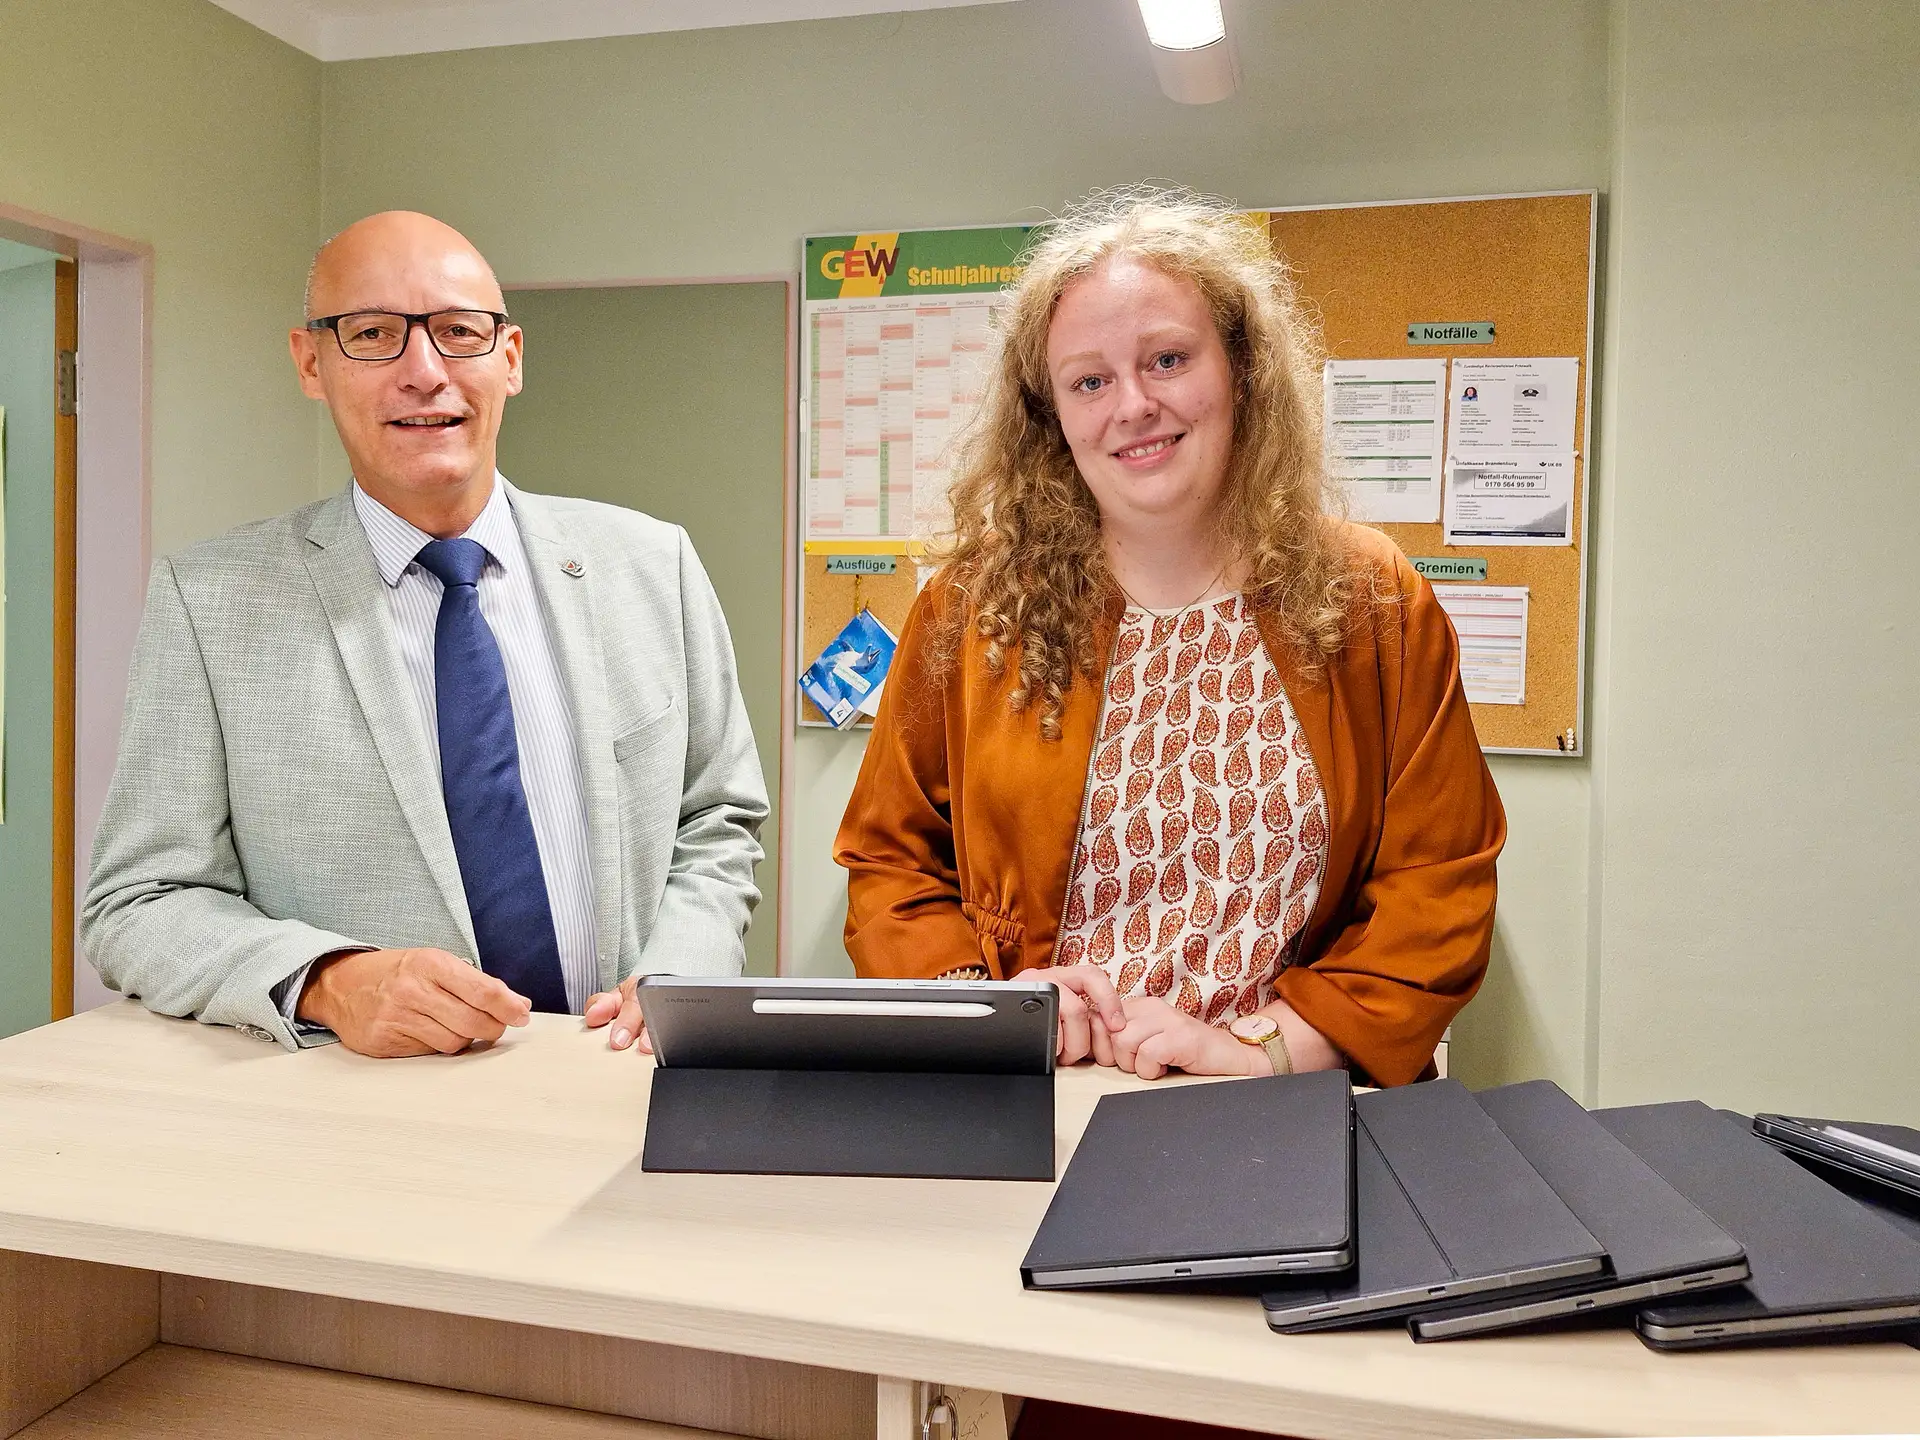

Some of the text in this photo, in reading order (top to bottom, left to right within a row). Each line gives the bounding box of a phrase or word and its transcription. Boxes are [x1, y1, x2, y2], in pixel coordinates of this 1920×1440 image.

[820, 248, 900, 282] GEW
[1423, 327, 1478, 340] Notfälle
[1477, 473, 1542, 481] Notfall-Rufnummer
[835, 559, 886, 571] Ausflüge
[1415, 561, 1474, 574] Gremien
